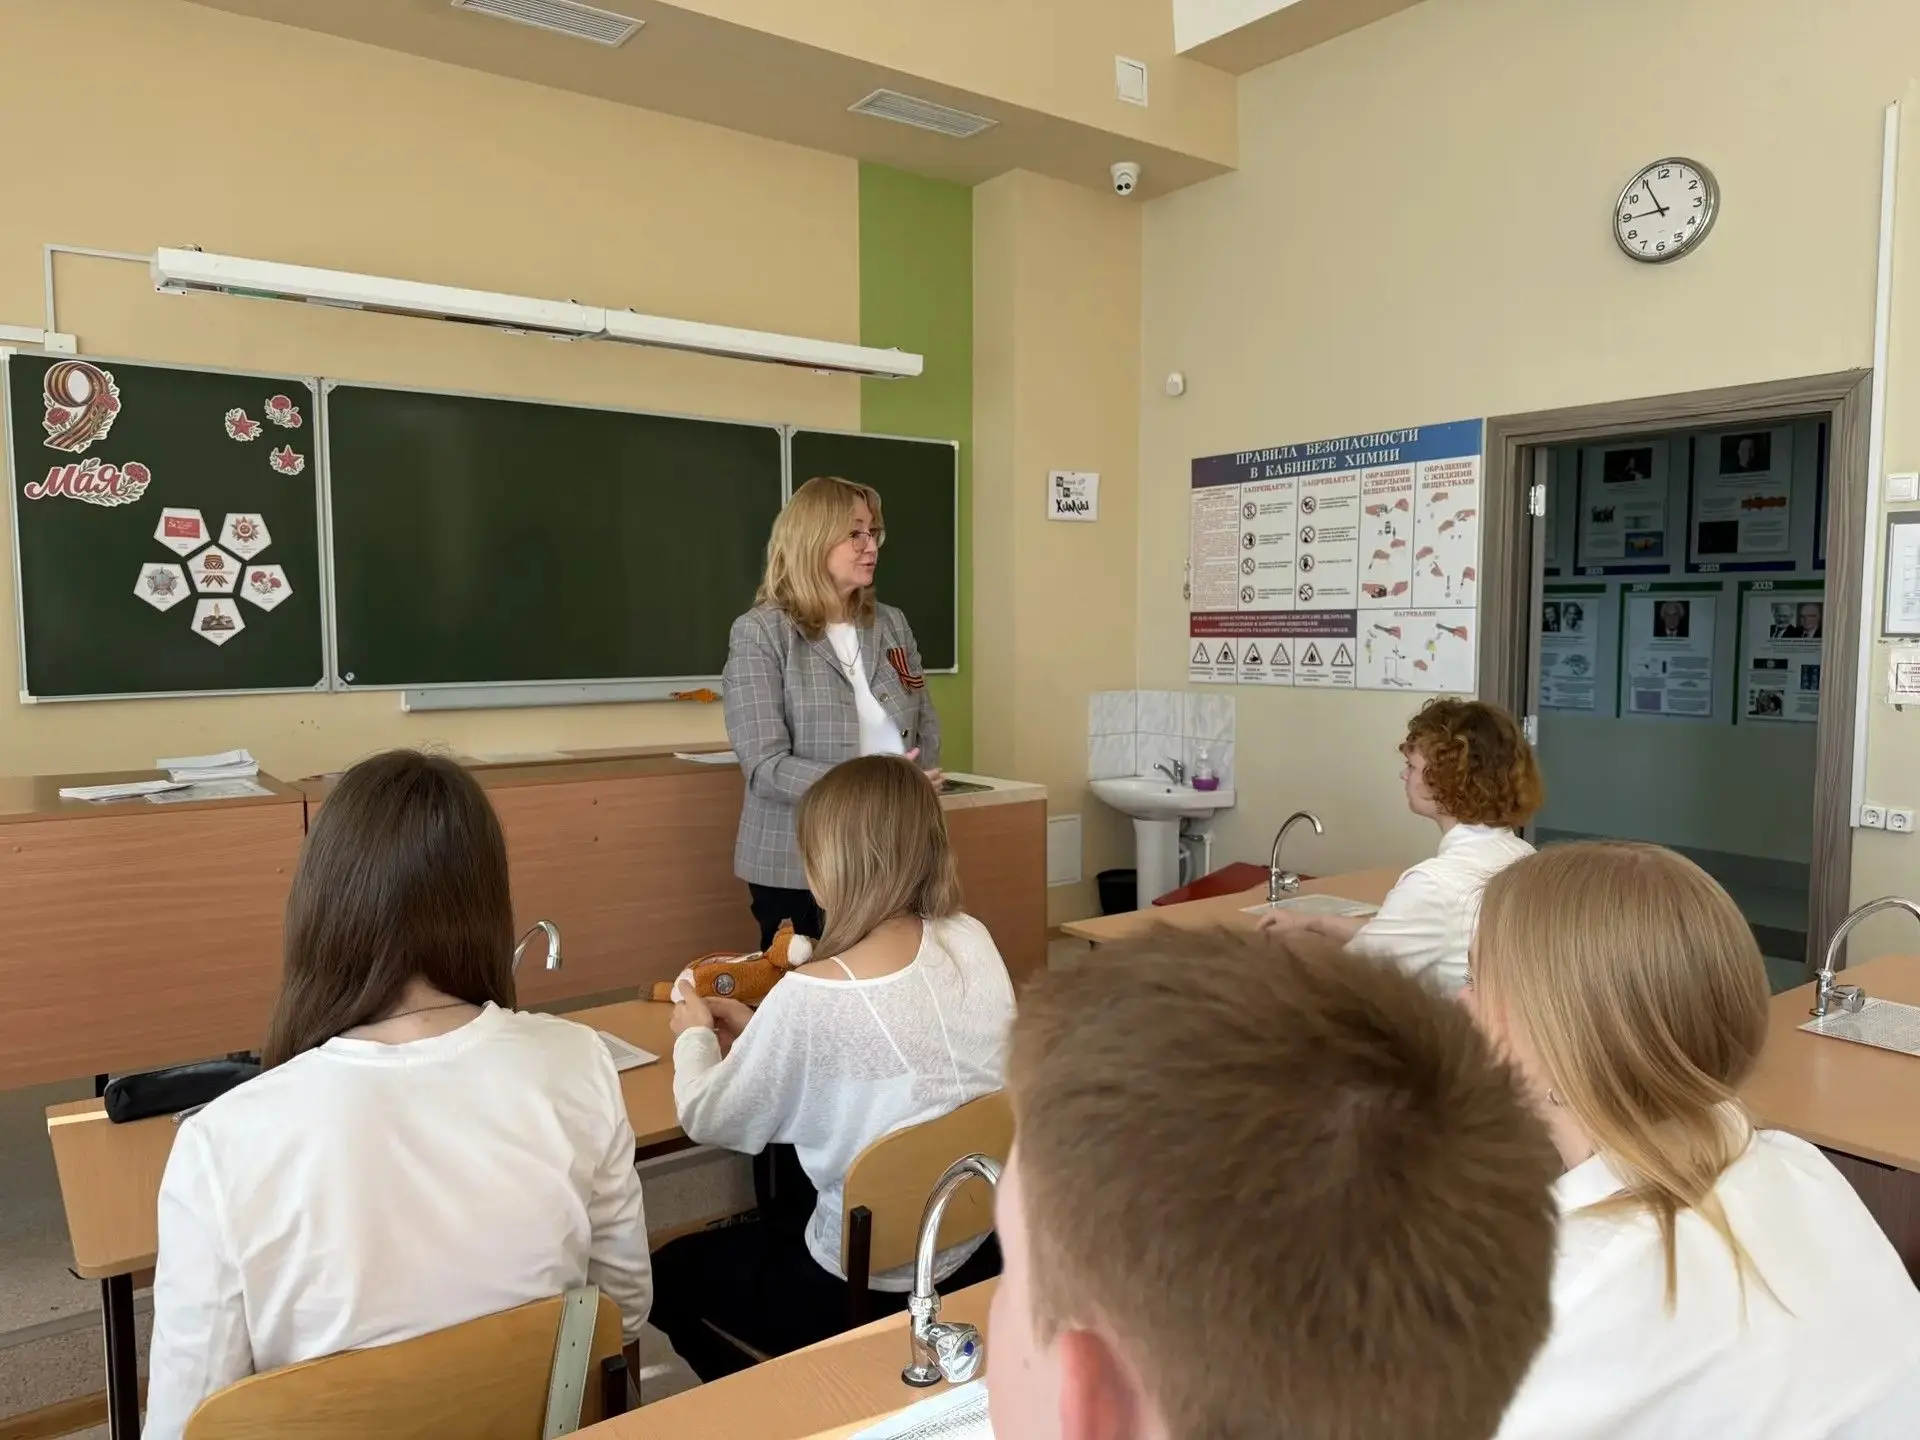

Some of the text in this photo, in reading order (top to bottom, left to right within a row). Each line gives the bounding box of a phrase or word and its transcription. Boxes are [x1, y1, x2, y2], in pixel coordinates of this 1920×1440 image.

[1658, 169, 1670, 179] 12
[1688, 180, 1698, 190] 2
[1629, 194, 1639, 204] 10
[1692, 196, 1703, 208] 3
[1622, 213, 1632, 223] 9
[1686, 216, 1697, 225] 4
[1627, 229, 1638, 240] 8
[1673, 232, 1684, 242] 5
[1639, 240, 1649, 250] 7
[1655, 241, 1666, 251] 6
[44, 361, 109, 451] 9
[1236, 428, 1419, 465] ПРАВИЛА БЕЗОПАСНОСТИ
[1250, 448, 1400, 479] В КАБИНЕТЕ ХИМИИ
[1424, 462, 1472, 473] ОБРАЩЕНИЕ
[1365, 468, 1411, 479] ОБРАЩЕНИЕ
[25, 463, 128, 499] Мая
[1243, 482, 1293, 494] ЗАПРЕЩАЕТСЯ
